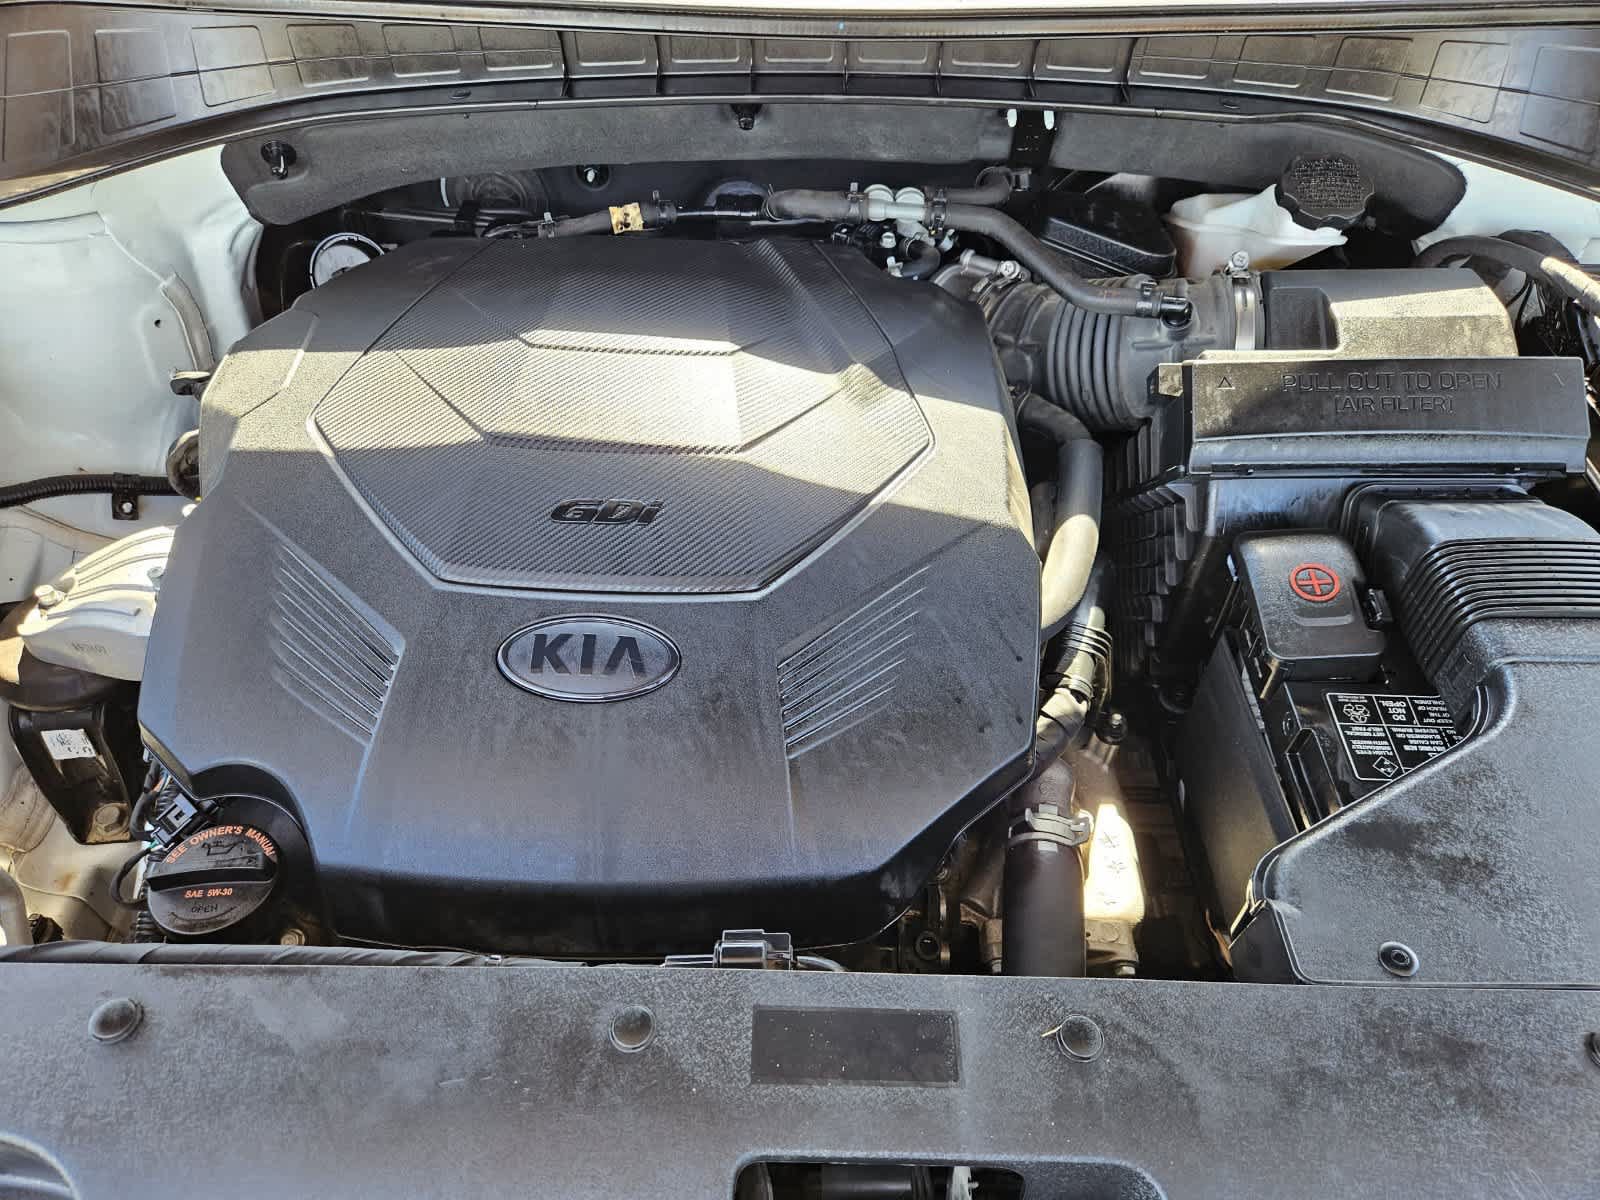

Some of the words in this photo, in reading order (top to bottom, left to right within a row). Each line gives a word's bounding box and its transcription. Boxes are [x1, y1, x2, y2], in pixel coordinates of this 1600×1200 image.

[1281, 371, 1341, 392] PULL
[1349, 371, 1395, 391] OUT
[1399, 371, 1432, 391] TO
[1439, 371, 1501, 391] OPEN
[550, 499, 664, 525] GDi
[530, 633, 648, 679] KIA
[166, 844, 188, 864] SEE
[190, 825, 244, 845] OWNER'S
[184, 889, 204, 898] SAE
[207, 887, 233, 897] 5W-30
[191, 903, 218, 913] OPEN
